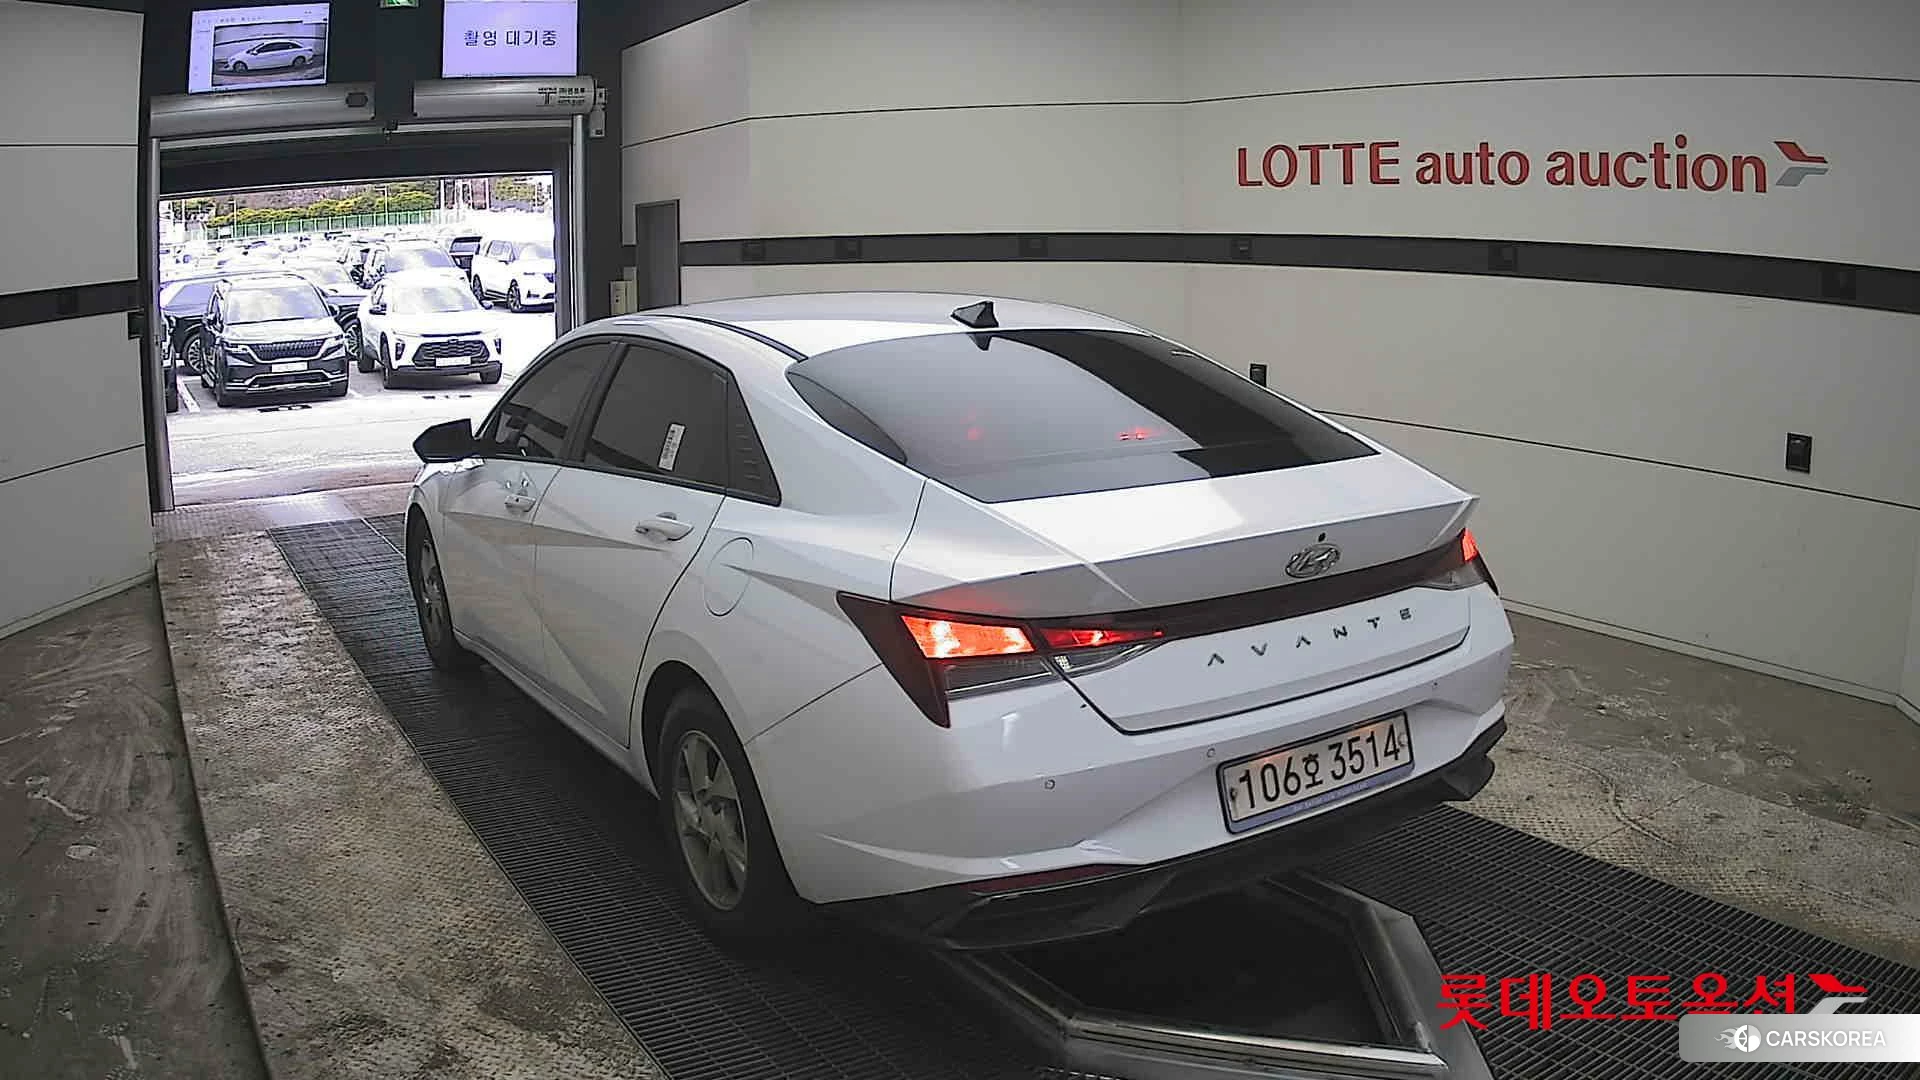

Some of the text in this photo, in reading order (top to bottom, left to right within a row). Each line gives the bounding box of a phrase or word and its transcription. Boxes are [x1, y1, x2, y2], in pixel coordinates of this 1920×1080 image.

[506, 30, 557, 47] 대기중
[1237, 134, 1767, 193] LOTTE auto auction
[1207, 607, 1412, 666] AVANTE
[1239, 753, 1324, 809] 106호
[1328, 724, 1400, 780] 3514
